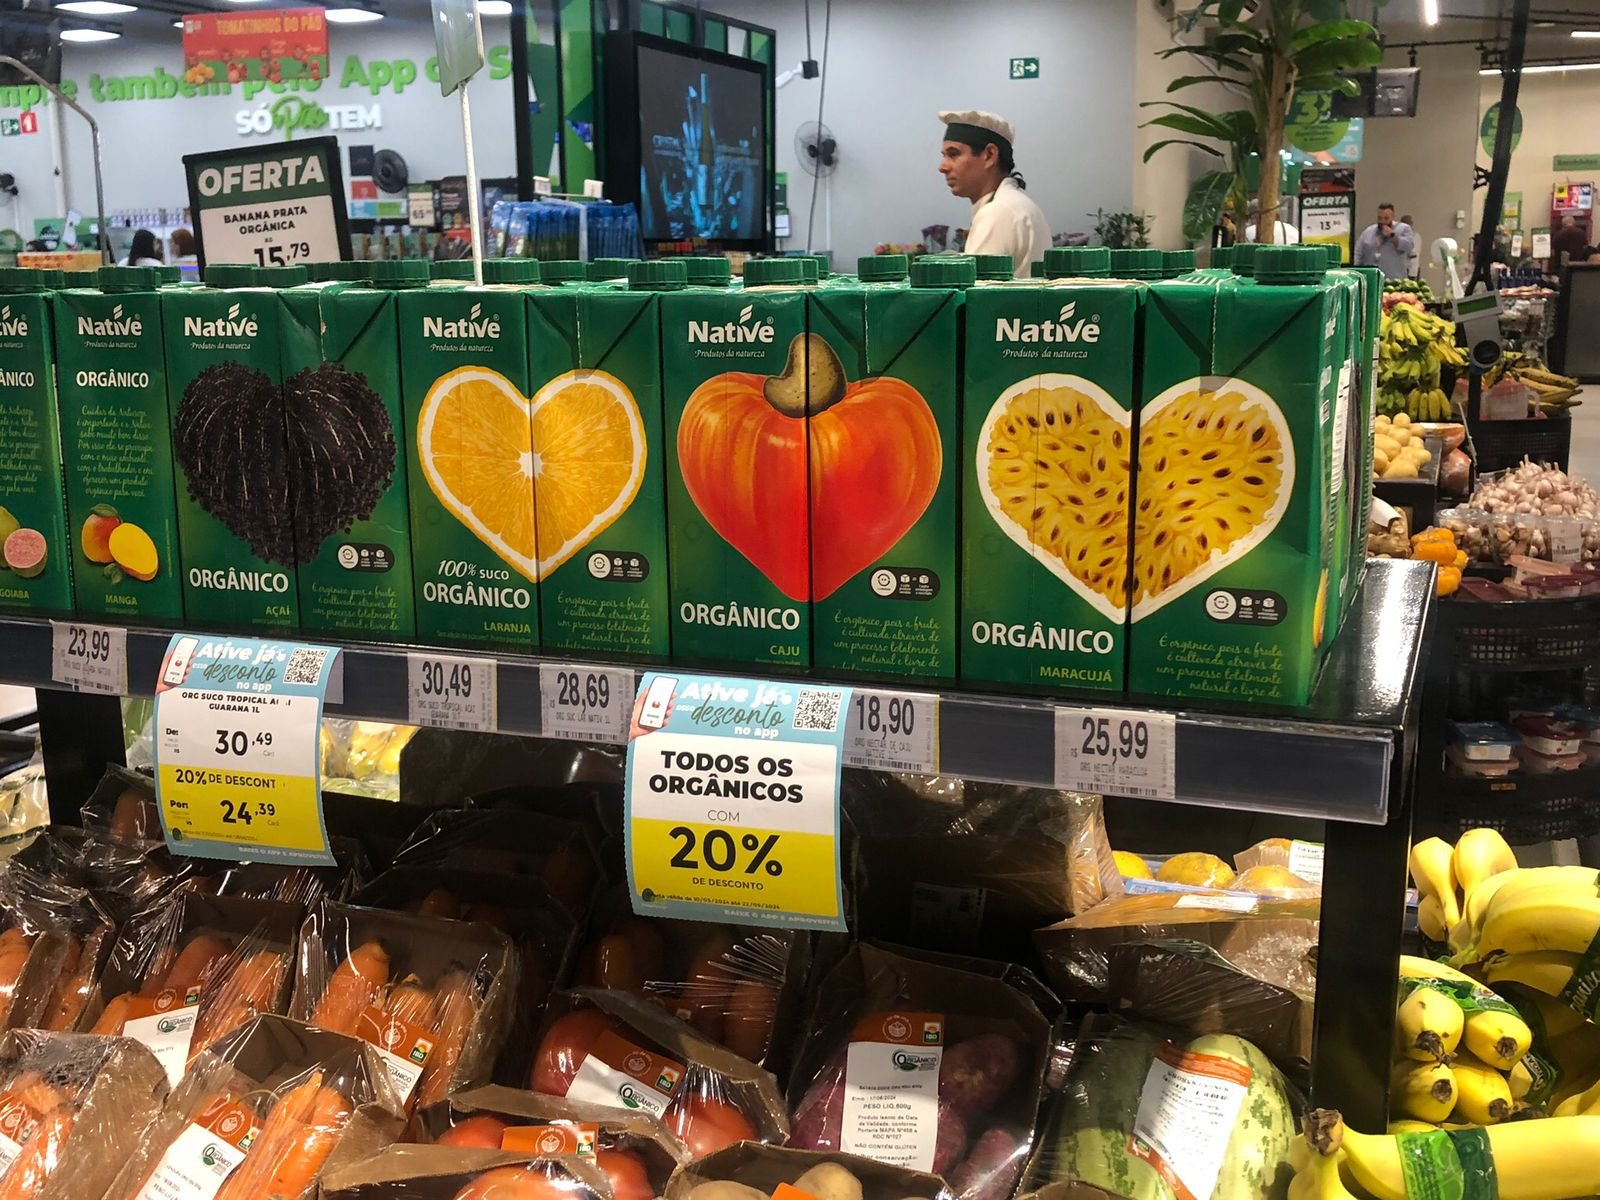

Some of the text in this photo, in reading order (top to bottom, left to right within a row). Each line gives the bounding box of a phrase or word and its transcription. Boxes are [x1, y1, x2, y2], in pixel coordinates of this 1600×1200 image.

[283, 16, 299, 33] DO
[301, 13, 322, 32] PÃO
[340, 55, 417, 96] App
[235, 102, 273, 134] SÓ
[325, 104, 383, 130] TEM
[198, 155, 325, 197] OFERTA
[1303, 196, 1349, 206] OFERTA
[224, 206, 308, 224] BANANA PRATA
[239, 220, 296, 235] ORGÂNICA
[77, 311, 143, 336] Native
[184, 310, 258, 337] Native
[423, 310, 501, 338] Native
[688, 312, 775, 343] Native
[995, 309, 1100, 343] Native
[694, 347, 765, 358] Produtos da natureza
[1002, 346, 1088, 358] Produtos da natureza
[76, 368, 149, 388] ORGÂNICO
[189, 567, 289, 593] ORGÂNICO
[438, 559, 510, 581] 100% SUCO
[105, 594, 138, 606] MANGA
[423, 581, 531, 609] ORGÂNICO
[265, 605, 290, 617] AÇAÍ
[680, 601, 800, 630] ORGÂNICO
[834, 609, 842, 623] É
[882, 619, 903, 632] pois
[913, 616, 940, 631] fruta
[484, 621, 531, 634] LARANJA
[848, 626, 891, 639] cultivada
[892, 629, 926, 642] através
[928, 630, 940, 642] de
[971, 621, 1115, 655] ORGÂNICO
[68, 625, 110, 664] 23,99
[197, 641, 276, 666] Ative já
[769, 645, 800, 656] CAJU
[833, 640, 940, 655] um processo totalmente
[203, 652, 278, 683] desconto
[861, 652, 896, 665] natural
[904, 654, 927, 667] livre
[928, 655, 940, 668] de
[422, 660, 472, 703] 30,49
[1039, 666, 1113, 683] MARACUJÁ
[181, 691, 199, 700] ORG
[201, 692, 224, 701] SUCO
[226, 694, 267, 705] TROPICAL
[236, 681, 272, 693] no app
[556, 671, 610, 714] 28,69
[680, 681, 778, 708] Ative já
[208, 703, 260, 714] GUARANA 1L
[691, 694, 785, 729] desconto
[856, 694, 915, 740] 18,90
[165, 728, 179, 736] De:
[215, 729, 273, 756] 30,49
[734, 726, 779, 740] no app
[1081, 716, 1149, 766] 25,99
[660, 750, 793, 777] TODOS OS
[175, 768, 207, 785] 20%
[209, 773, 223, 784] DE
[649, 773, 804, 804] ORGÂNICOS
[170, 799, 189, 809] Por:
[219, 799, 276, 825] 24,39
[707, 809, 740, 823] COM
[668, 826, 783, 877] 20%
[692, 877, 764, 891] DE DESCONTO
[412, 1050, 424, 1059] IBD
